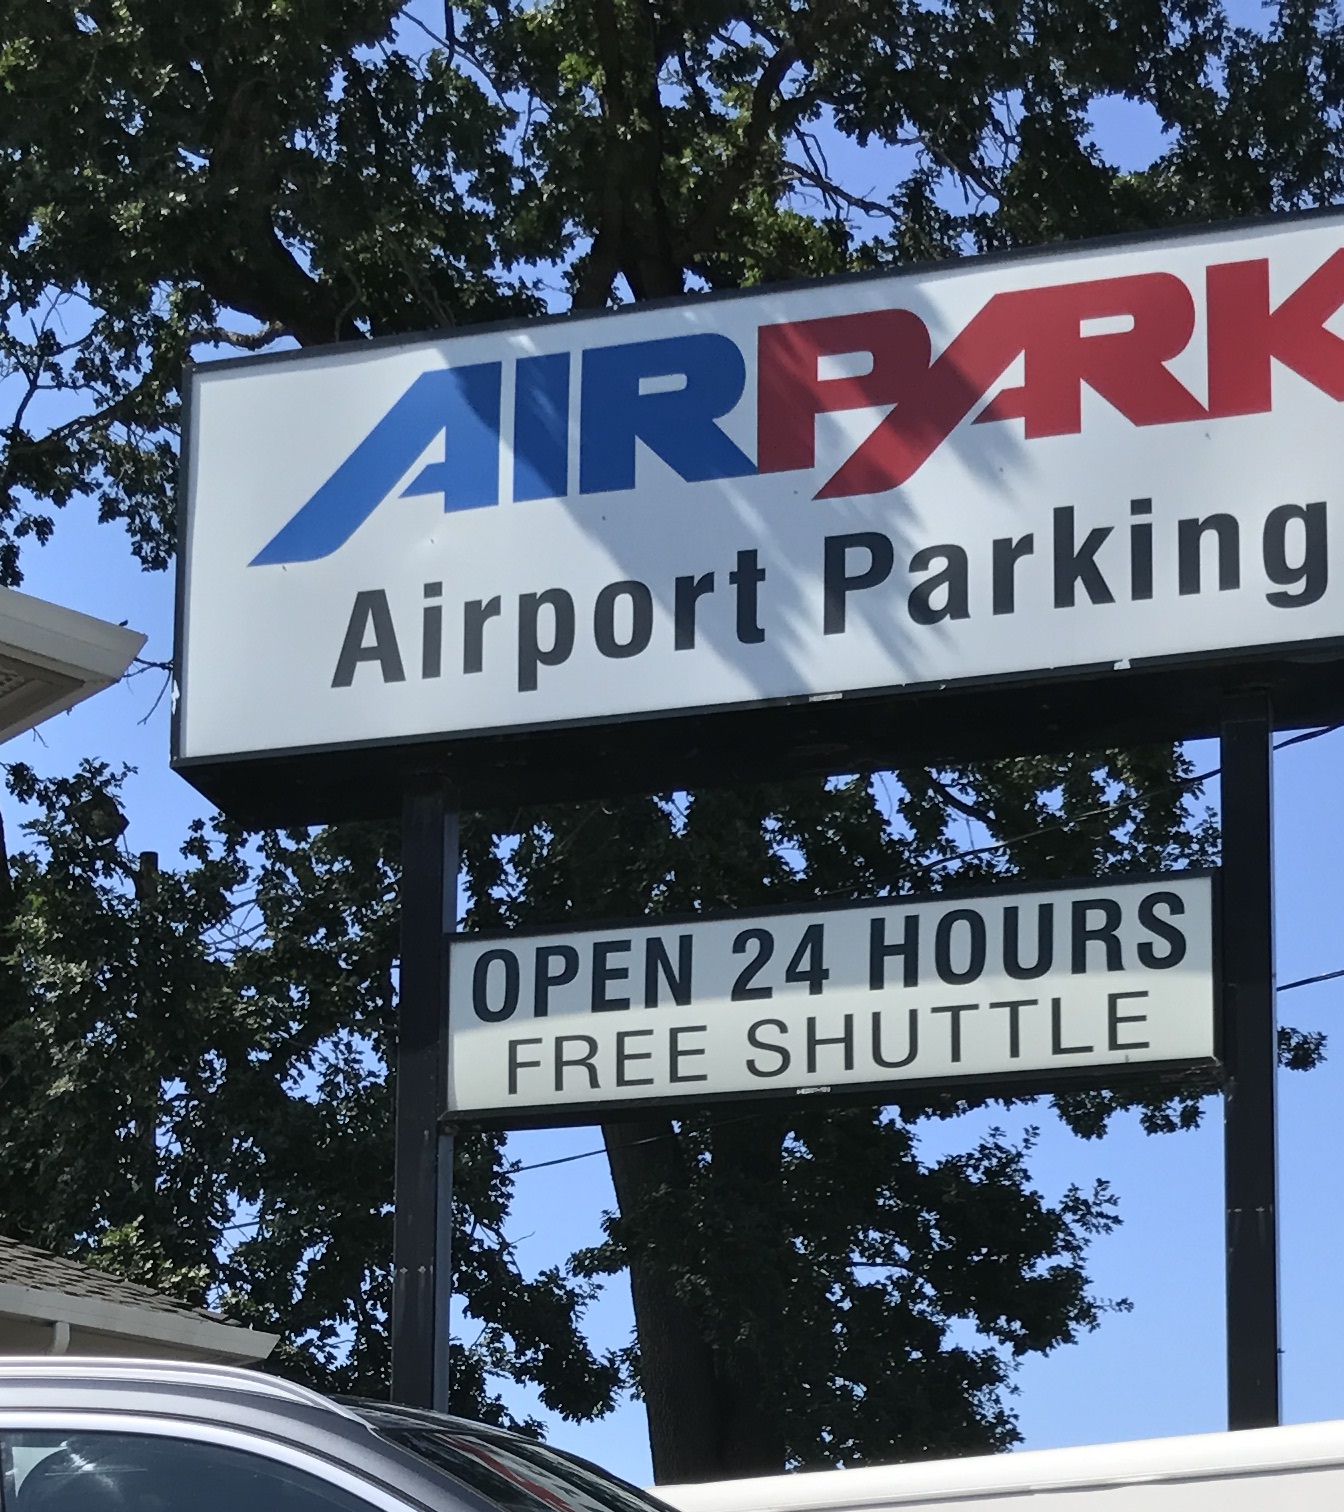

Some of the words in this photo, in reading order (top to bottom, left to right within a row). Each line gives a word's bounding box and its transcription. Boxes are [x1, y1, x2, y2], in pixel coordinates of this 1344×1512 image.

[331, 549, 767, 692] Airport
[823, 499, 1330, 636] Parking
[471, 933, 694, 1023] OPEN
[731, 923, 830, 1002] 24
[869, 890, 1188, 991] HOURS
[507, 1025, 708, 1096] FREE
[746, 990, 1151, 1078] SHUTTLE
